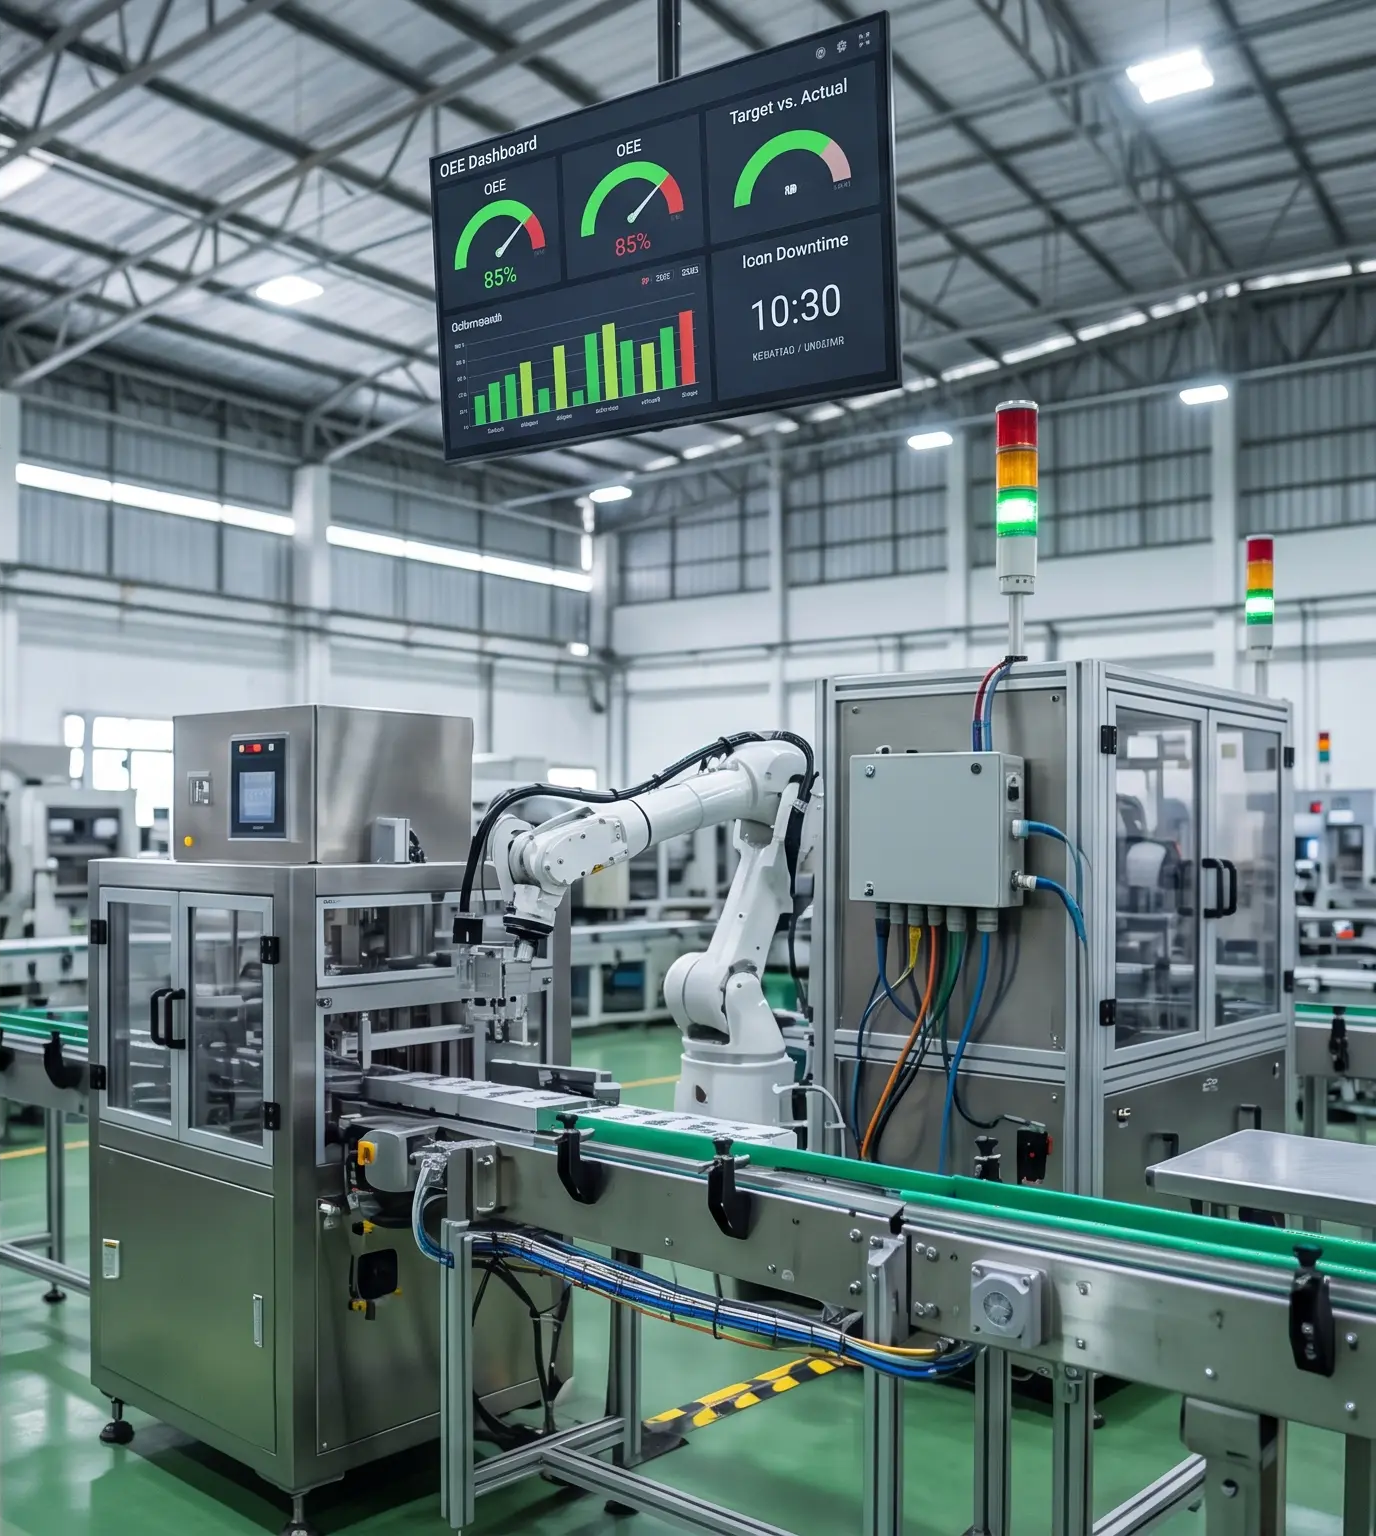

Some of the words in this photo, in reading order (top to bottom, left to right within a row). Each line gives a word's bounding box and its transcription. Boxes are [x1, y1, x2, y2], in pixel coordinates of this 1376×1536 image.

[730, 97, 774, 125] Target
[777, 96, 797, 112] vs.
[800, 77, 848, 105] Actual
[440, 157, 466, 178] OEE
[468, 134, 538, 169] Dashboard
[616, 138, 642, 158] OEE
[484, 178, 507, 196] OEE
[615, 232, 651, 257] 85%
[776, 234, 849, 262] Downtime
[484, 266, 517, 289] 85%
[751, 283, 841, 331] 10:30
